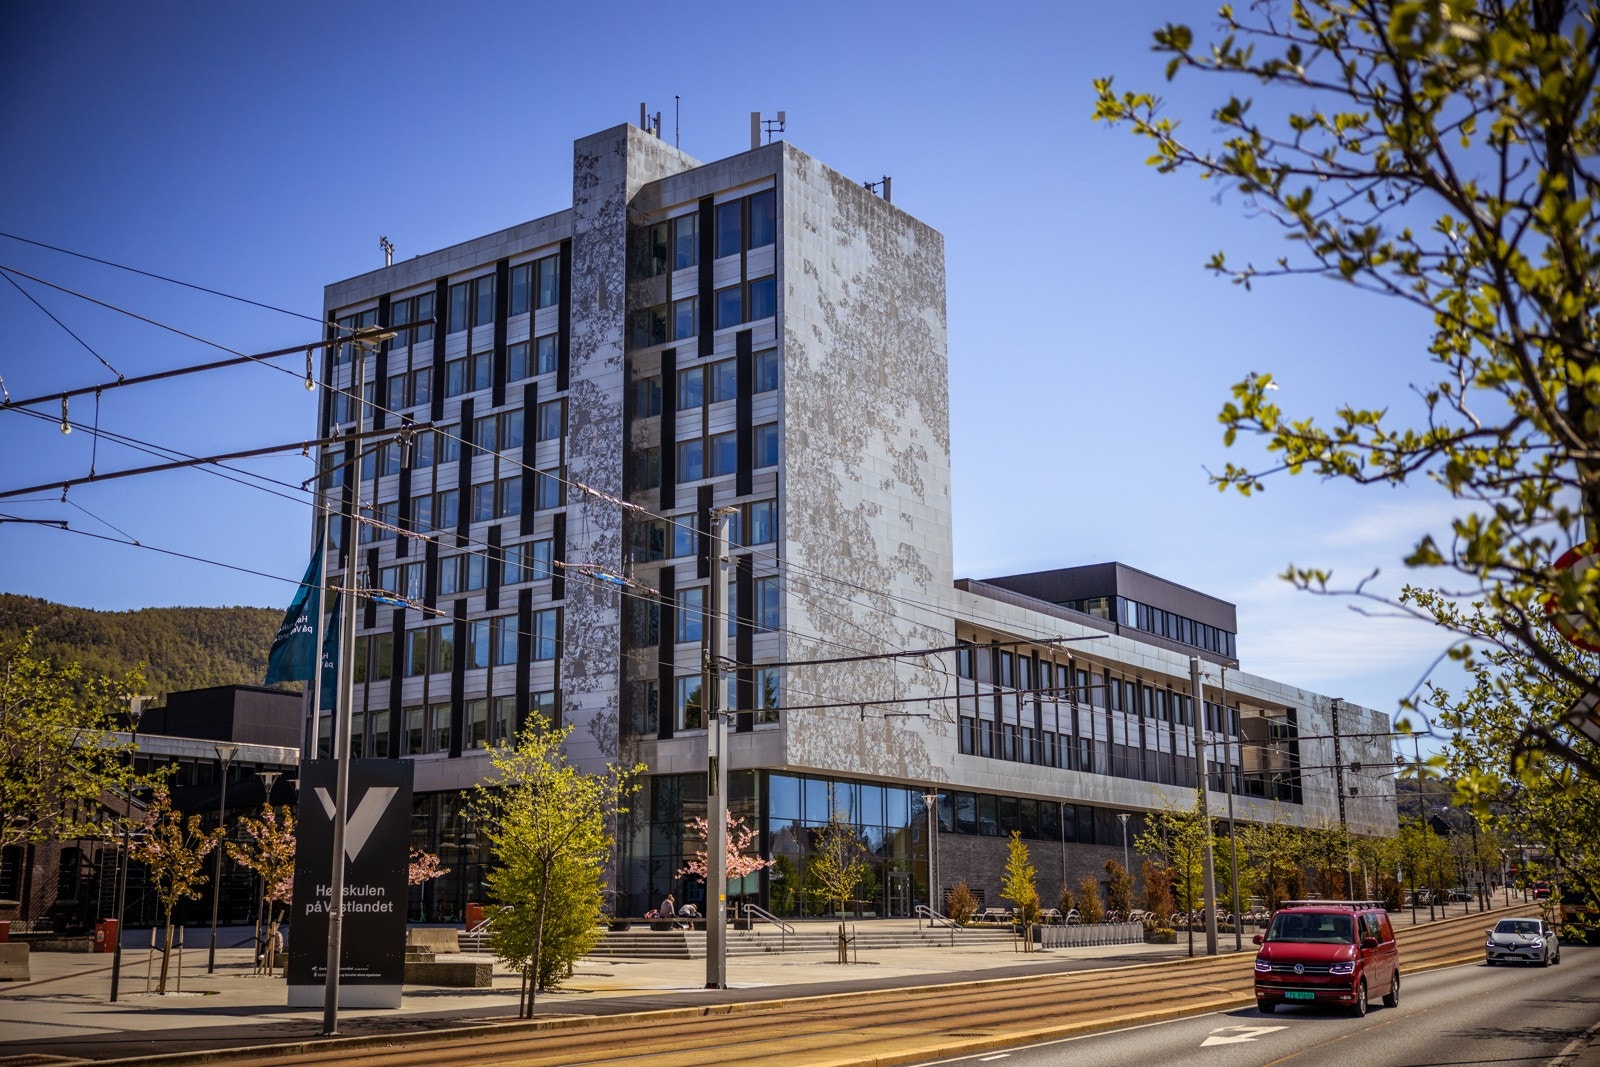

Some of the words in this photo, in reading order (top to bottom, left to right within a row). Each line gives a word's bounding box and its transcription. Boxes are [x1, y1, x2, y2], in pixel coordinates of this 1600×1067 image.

[315, 884, 385, 896] Høskulen
[305, 901, 322, 916] på
[323, 900, 394, 913] Vstlandet
